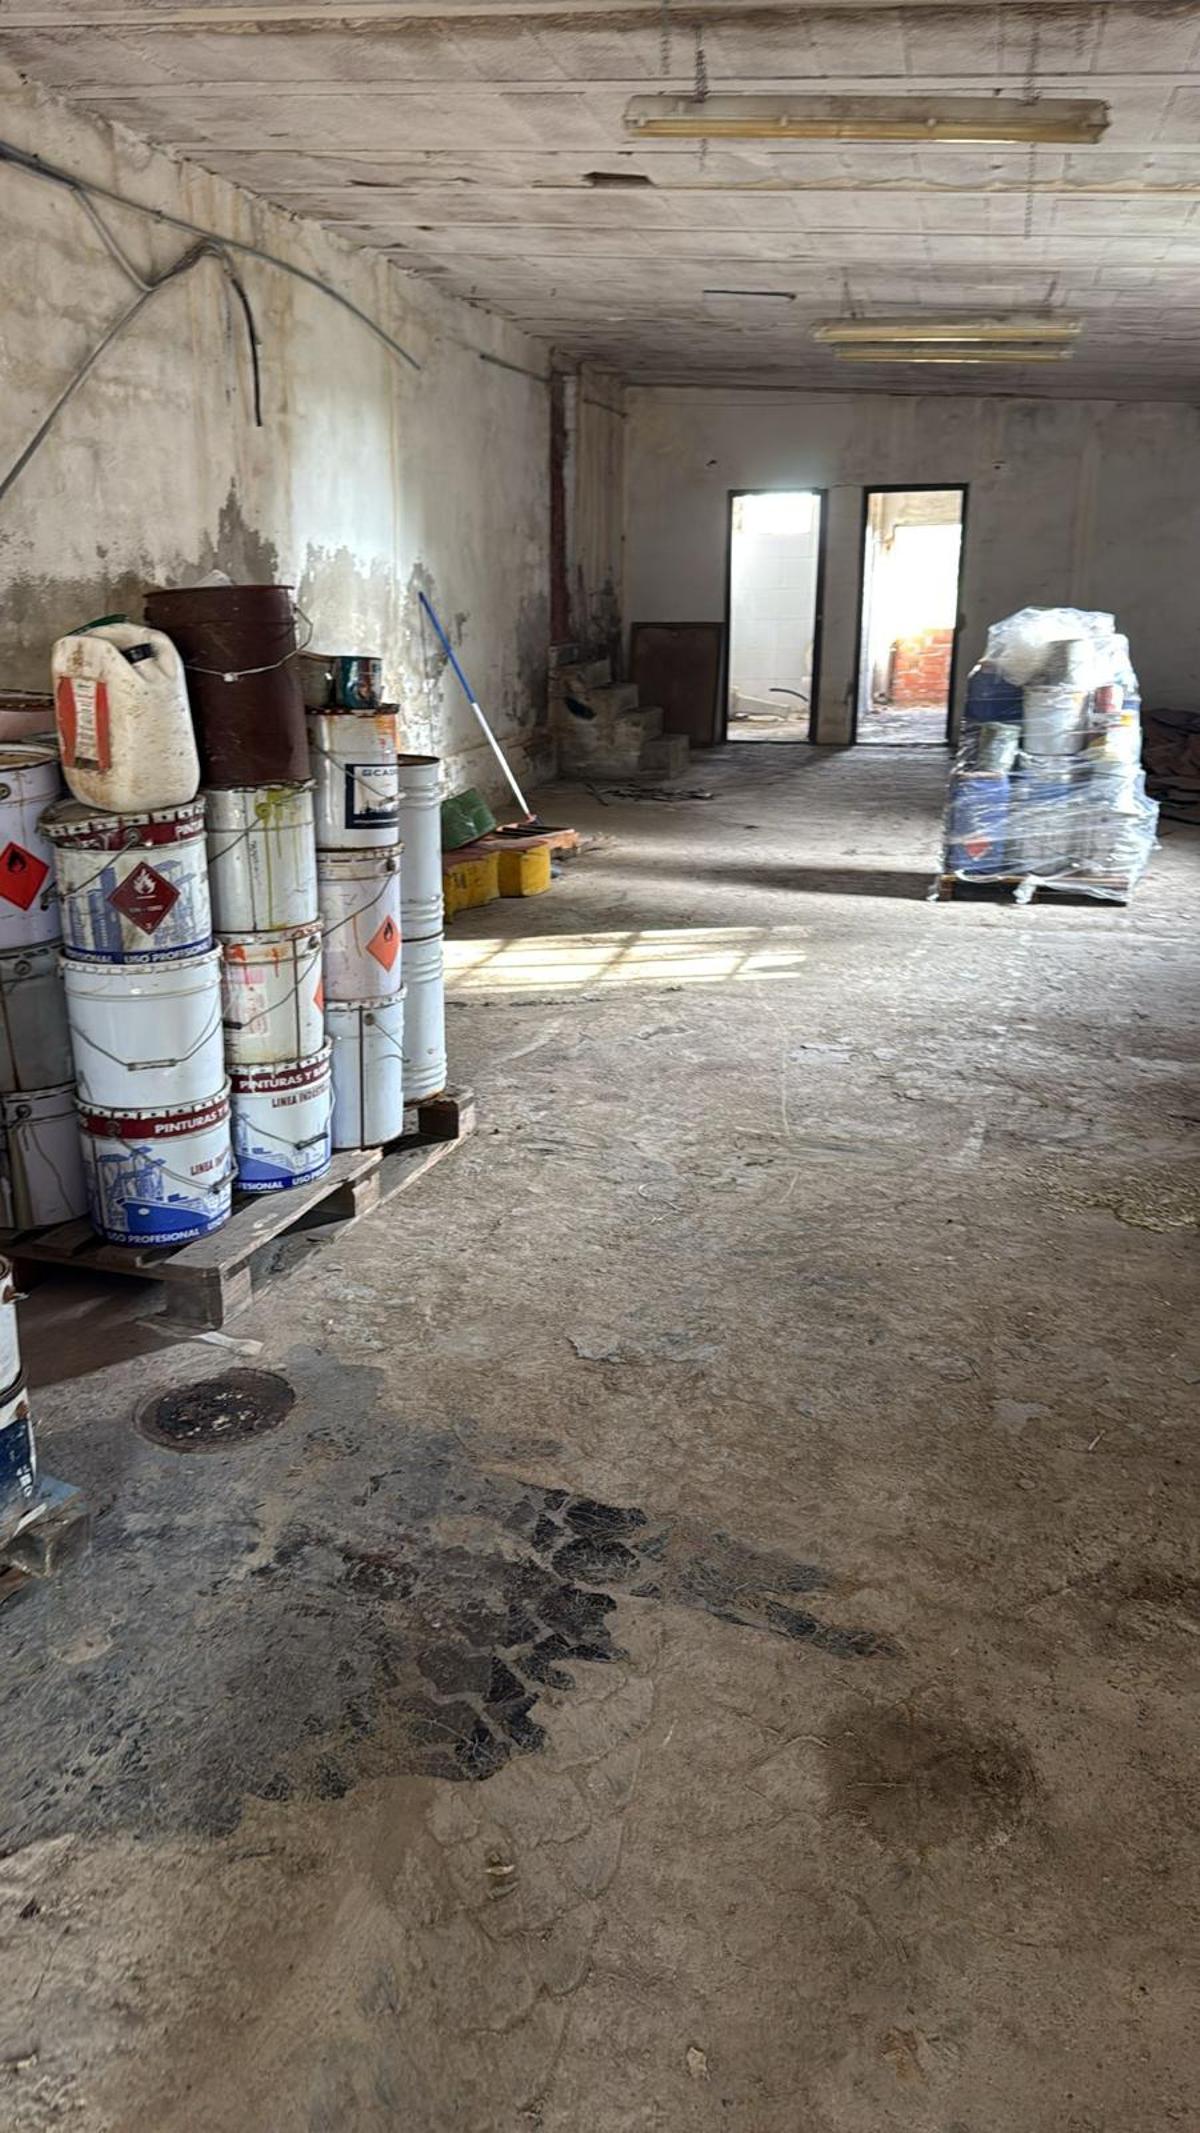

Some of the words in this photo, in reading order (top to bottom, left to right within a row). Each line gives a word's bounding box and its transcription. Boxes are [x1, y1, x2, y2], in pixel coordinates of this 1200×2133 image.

[240, 1073, 303, 1089] PINTURAS
[304, 1071, 313, 1080] Y
[154, 1111, 217, 1134] PINTURAS
[127, 1228, 200, 1244] PROFESIONAL
